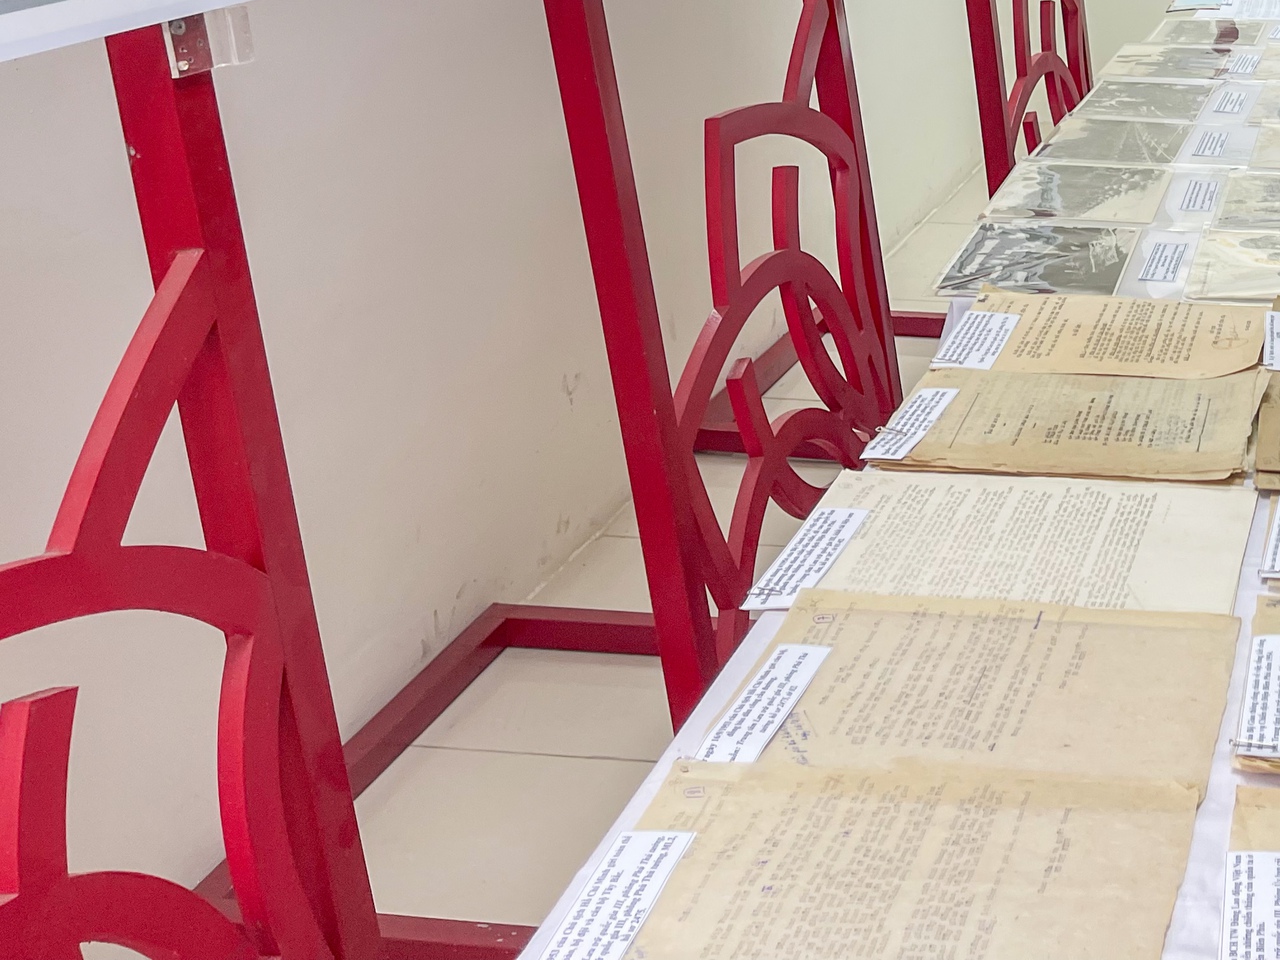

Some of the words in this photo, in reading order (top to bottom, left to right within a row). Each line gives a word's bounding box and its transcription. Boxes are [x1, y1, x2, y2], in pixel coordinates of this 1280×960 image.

[1233, 855, 1241, 868] Nam
[1233, 869, 1242, 881] Việt
[1244, 866, 1255, 880] quân
[1232, 882, 1242, 896] động
[1244, 882, 1253, 892] của
[1231, 898, 1239, 909] Lao
[1241, 893, 1254, 910] thắng
[1231, 910, 1241, 926] Đảng
[1240, 911, 1252, 927] chiến
[1230, 928, 1238, 939] TW
[1254, 922, 1265, 936] Phủ.
[1243, 929, 1253, 949] những
[1253, 938, 1264, 952] Biên
[1229, 941, 1238, 957] BCH
